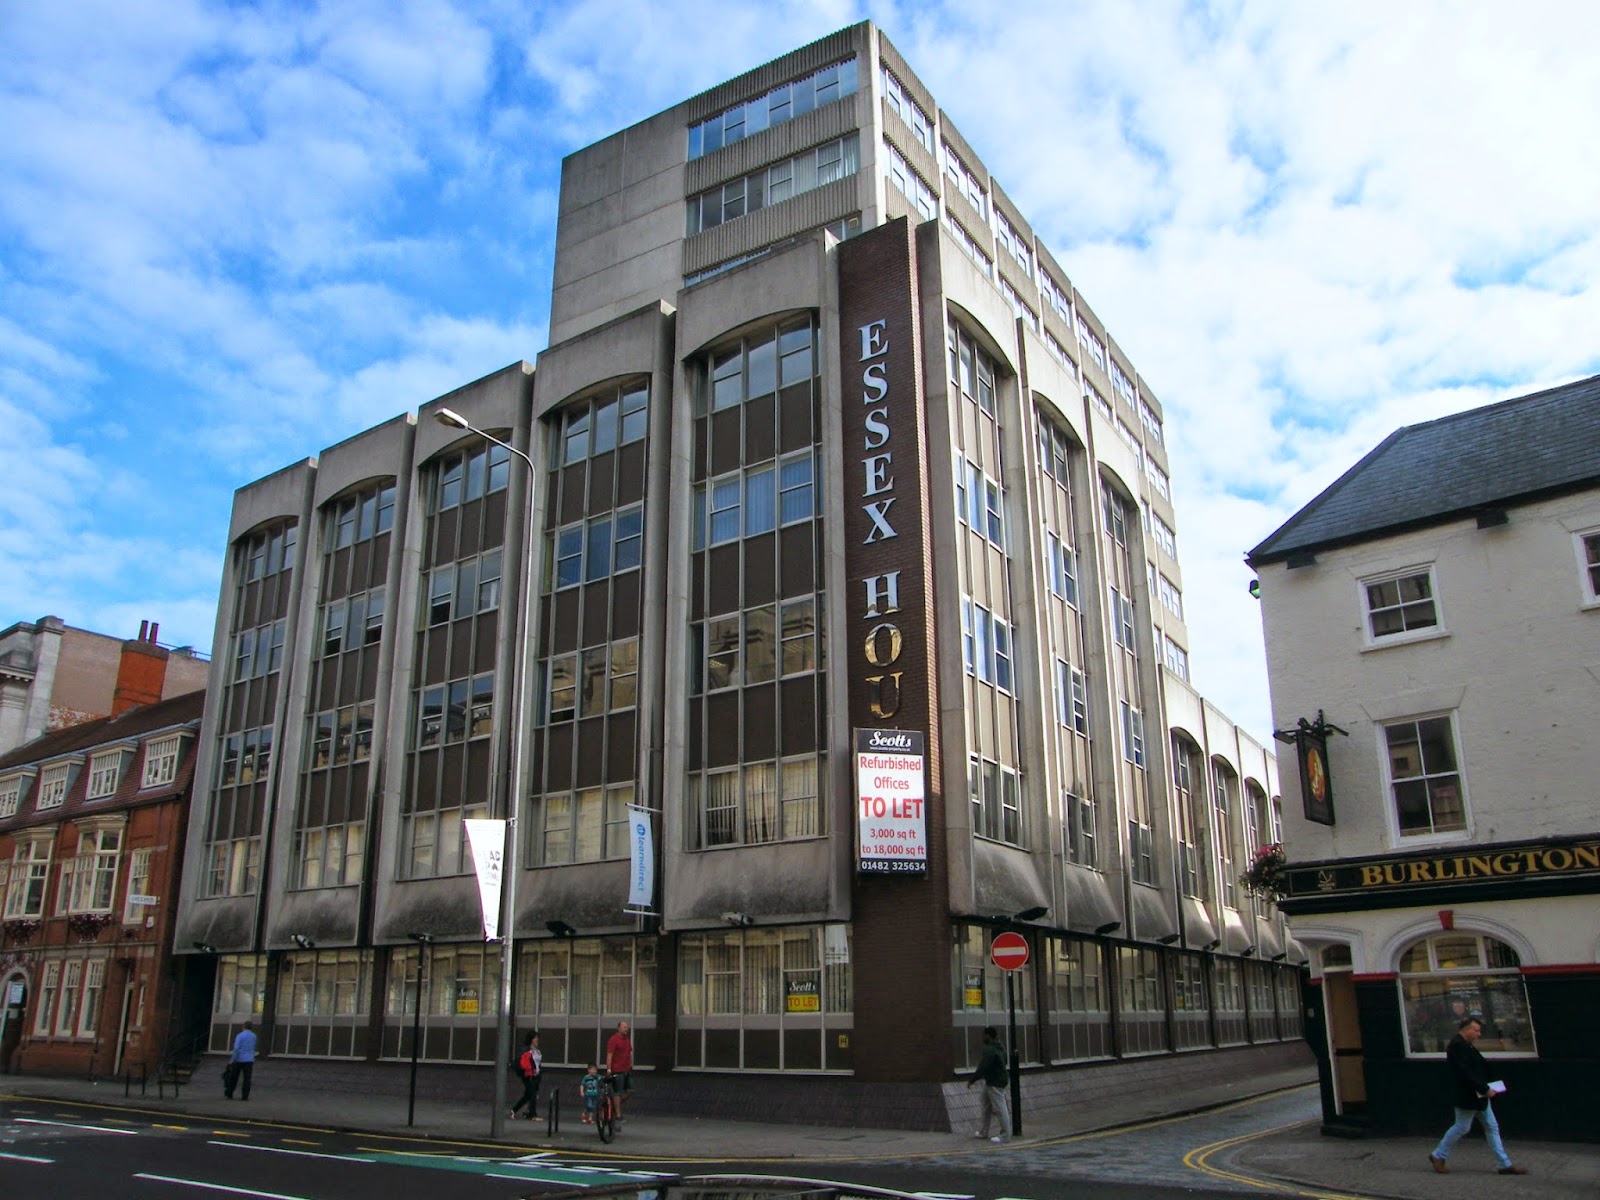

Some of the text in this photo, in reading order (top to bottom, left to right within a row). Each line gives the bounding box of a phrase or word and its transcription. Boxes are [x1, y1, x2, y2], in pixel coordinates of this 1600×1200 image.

[858, 318, 899, 545] ESSEX
[869, 730, 912, 747] Scotts
[859, 755, 922, 771] Refurbished
[873, 776, 910, 790] Offices
[860, 796, 924, 819] TO LET
[870, 828, 916, 840] 3,000 sq ft
[862, 844, 925, 856] to 18,000 sq ft
[637, 836, 646, 891] learndirect
[861, 860, 926, 871] 01482 325634
[1360, 845, 1600, 886] BURLINGTON
[789, 981, 816, 992] Scotts
[789, 997, 817, 1007] TO LET
